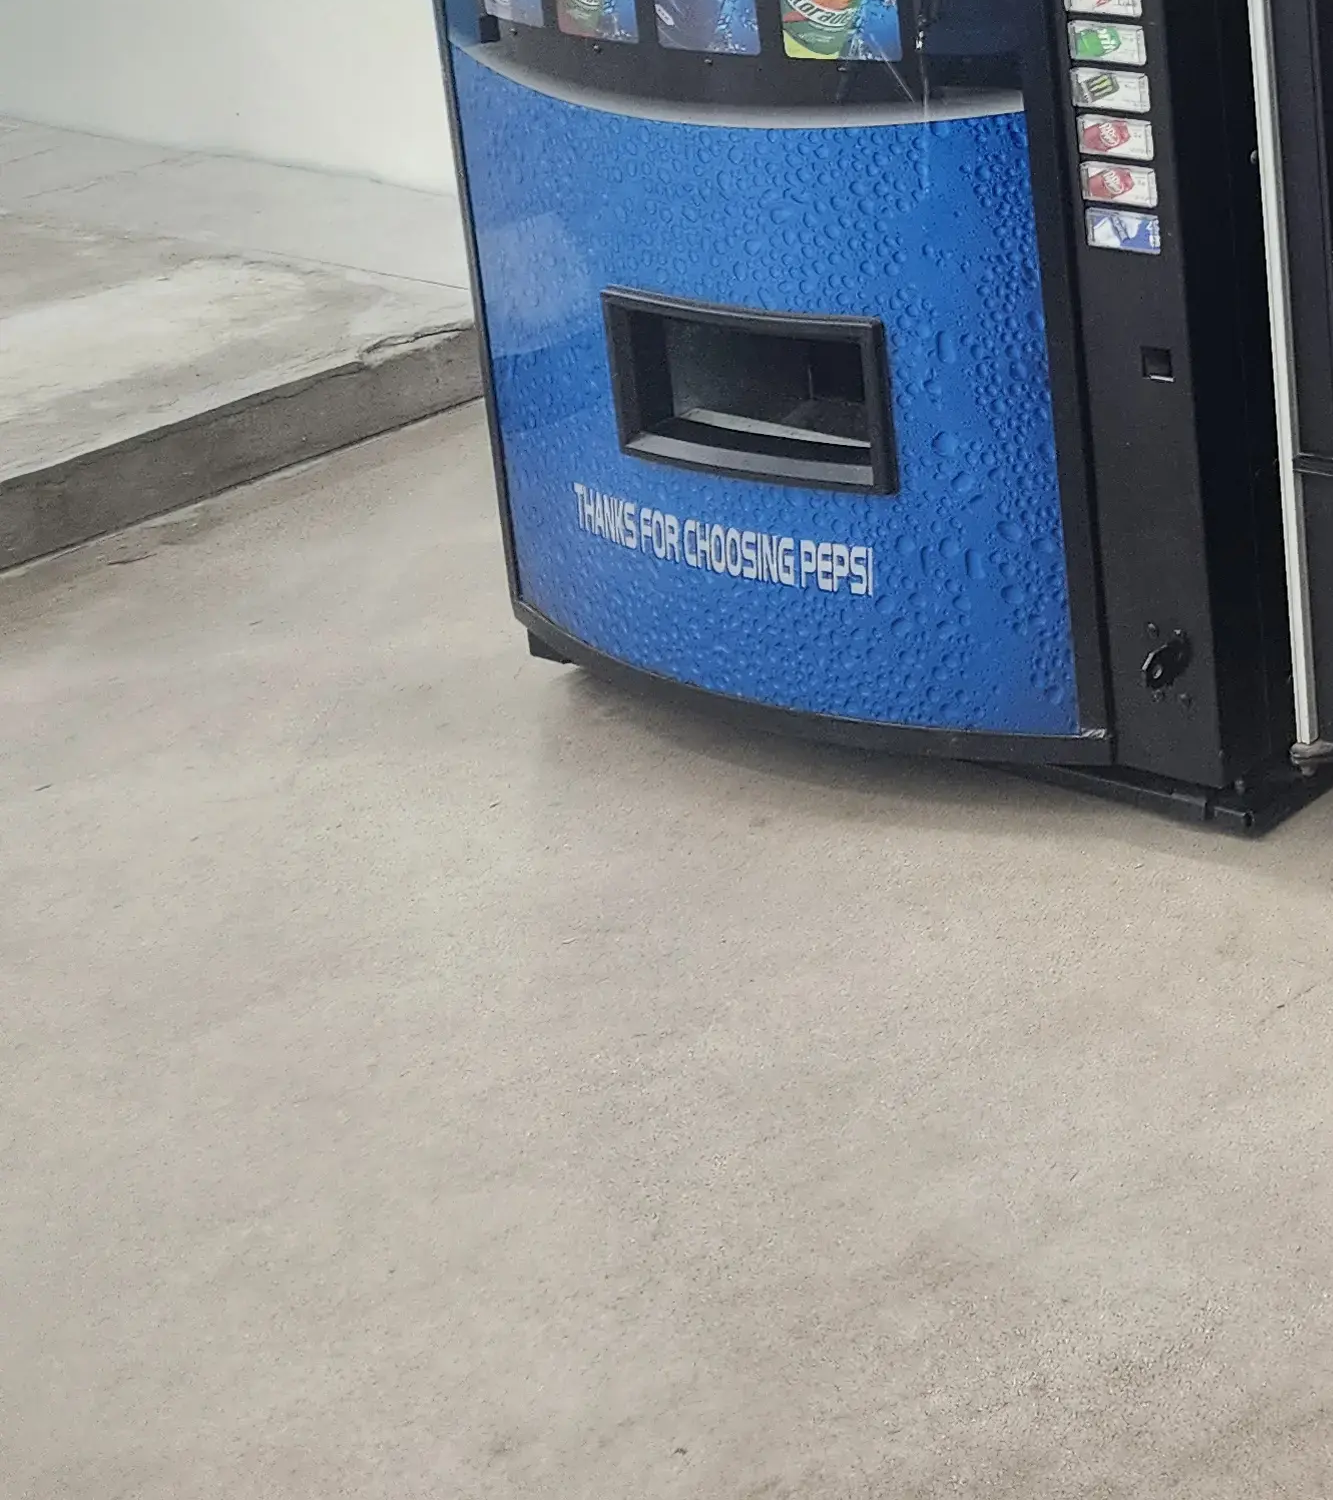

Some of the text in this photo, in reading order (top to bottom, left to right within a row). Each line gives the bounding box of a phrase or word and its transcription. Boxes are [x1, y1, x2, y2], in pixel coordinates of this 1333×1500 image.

[573, 481, 873, 597] THANKS FOR CHOOSING PEPSI
